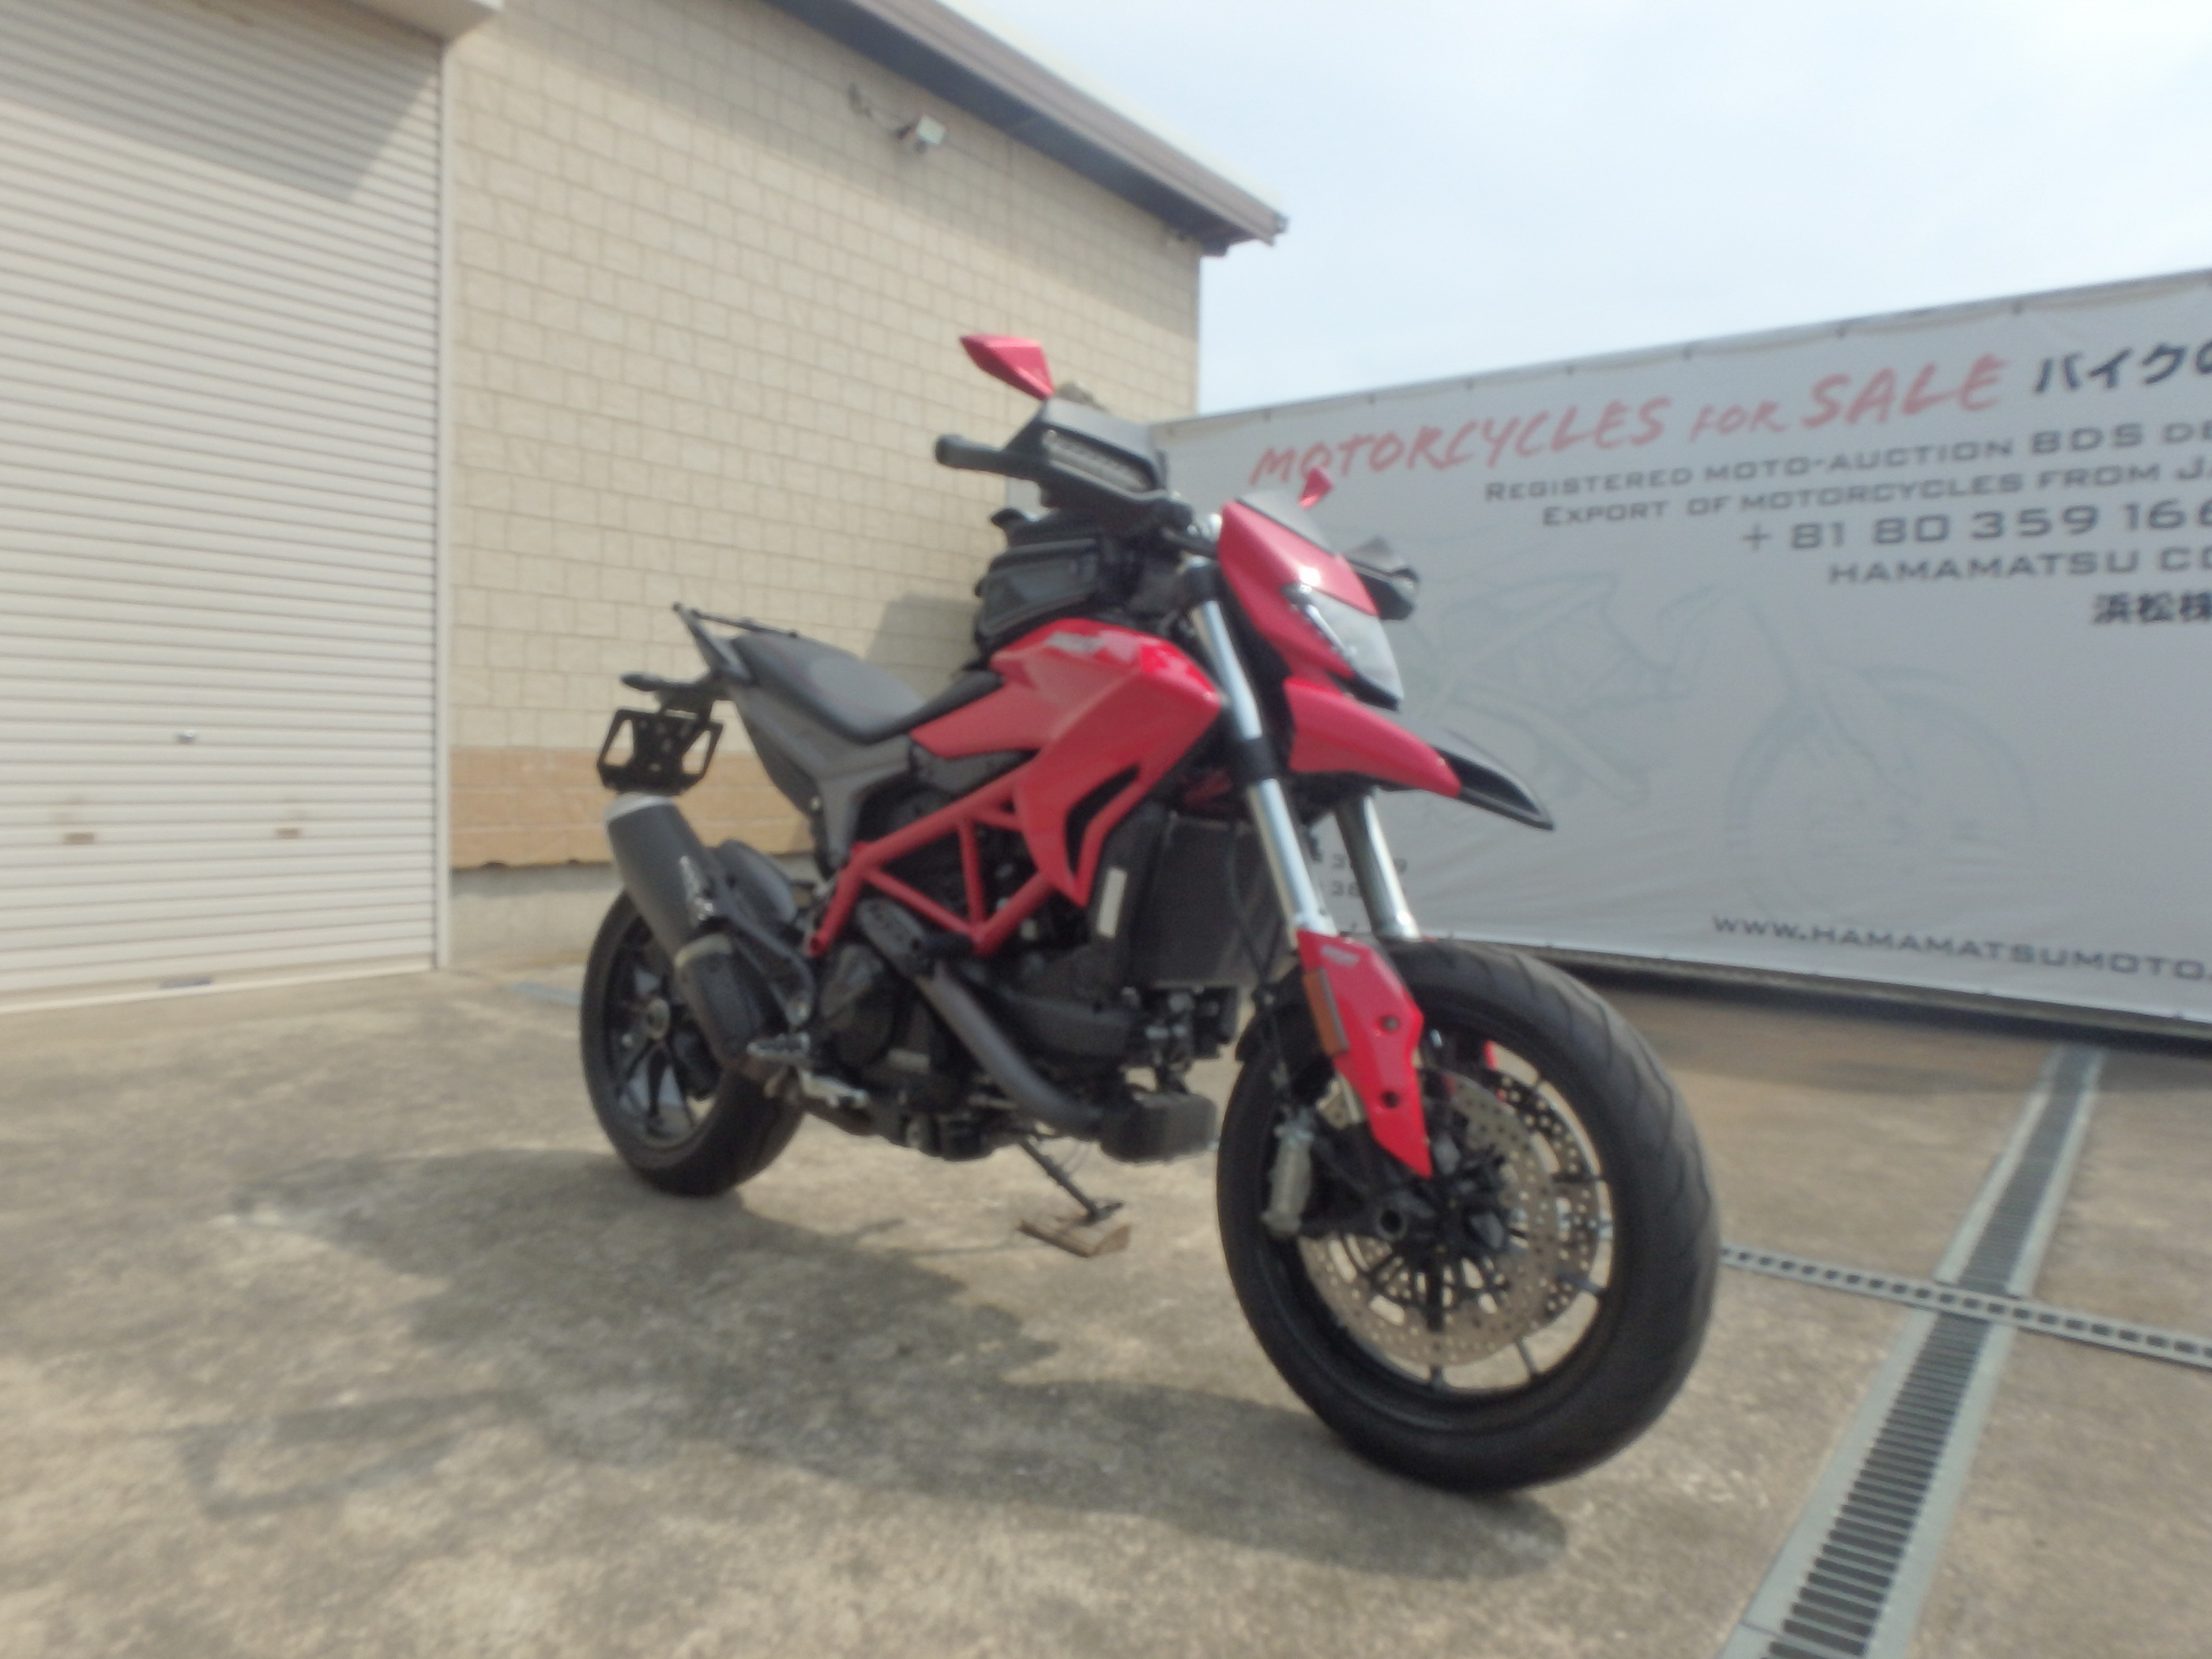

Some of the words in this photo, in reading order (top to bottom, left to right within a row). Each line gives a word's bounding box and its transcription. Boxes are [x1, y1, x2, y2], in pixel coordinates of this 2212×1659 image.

[1248, 396, 1672, 486] MOTORCYCLES
[1689, 398, 1789, 442] FOR
[1800, 353, 2012, 430] SALE
[1484, 466, 1693, 501] REGISTERED
[1704, 439, 2014, 481] MOTO-AUCTION
[2031, 422, 2143, 453] BDS
[1543, 499, 1668, 526] EXPORT
[1687, 494, 1731, 516] OF
[1740, 472, 2024, 511] MOTORCYCLES
[2038, 462, 2161, 488] FROM
[2176, 455, 2212, 480] J
[1790, 521, 1845, 549] 81
[1873, 514, 1950, 545] 80
[1969, 505, 2099, 540] 359
[1829, 549, 2140, 583] HAMAMATSU
